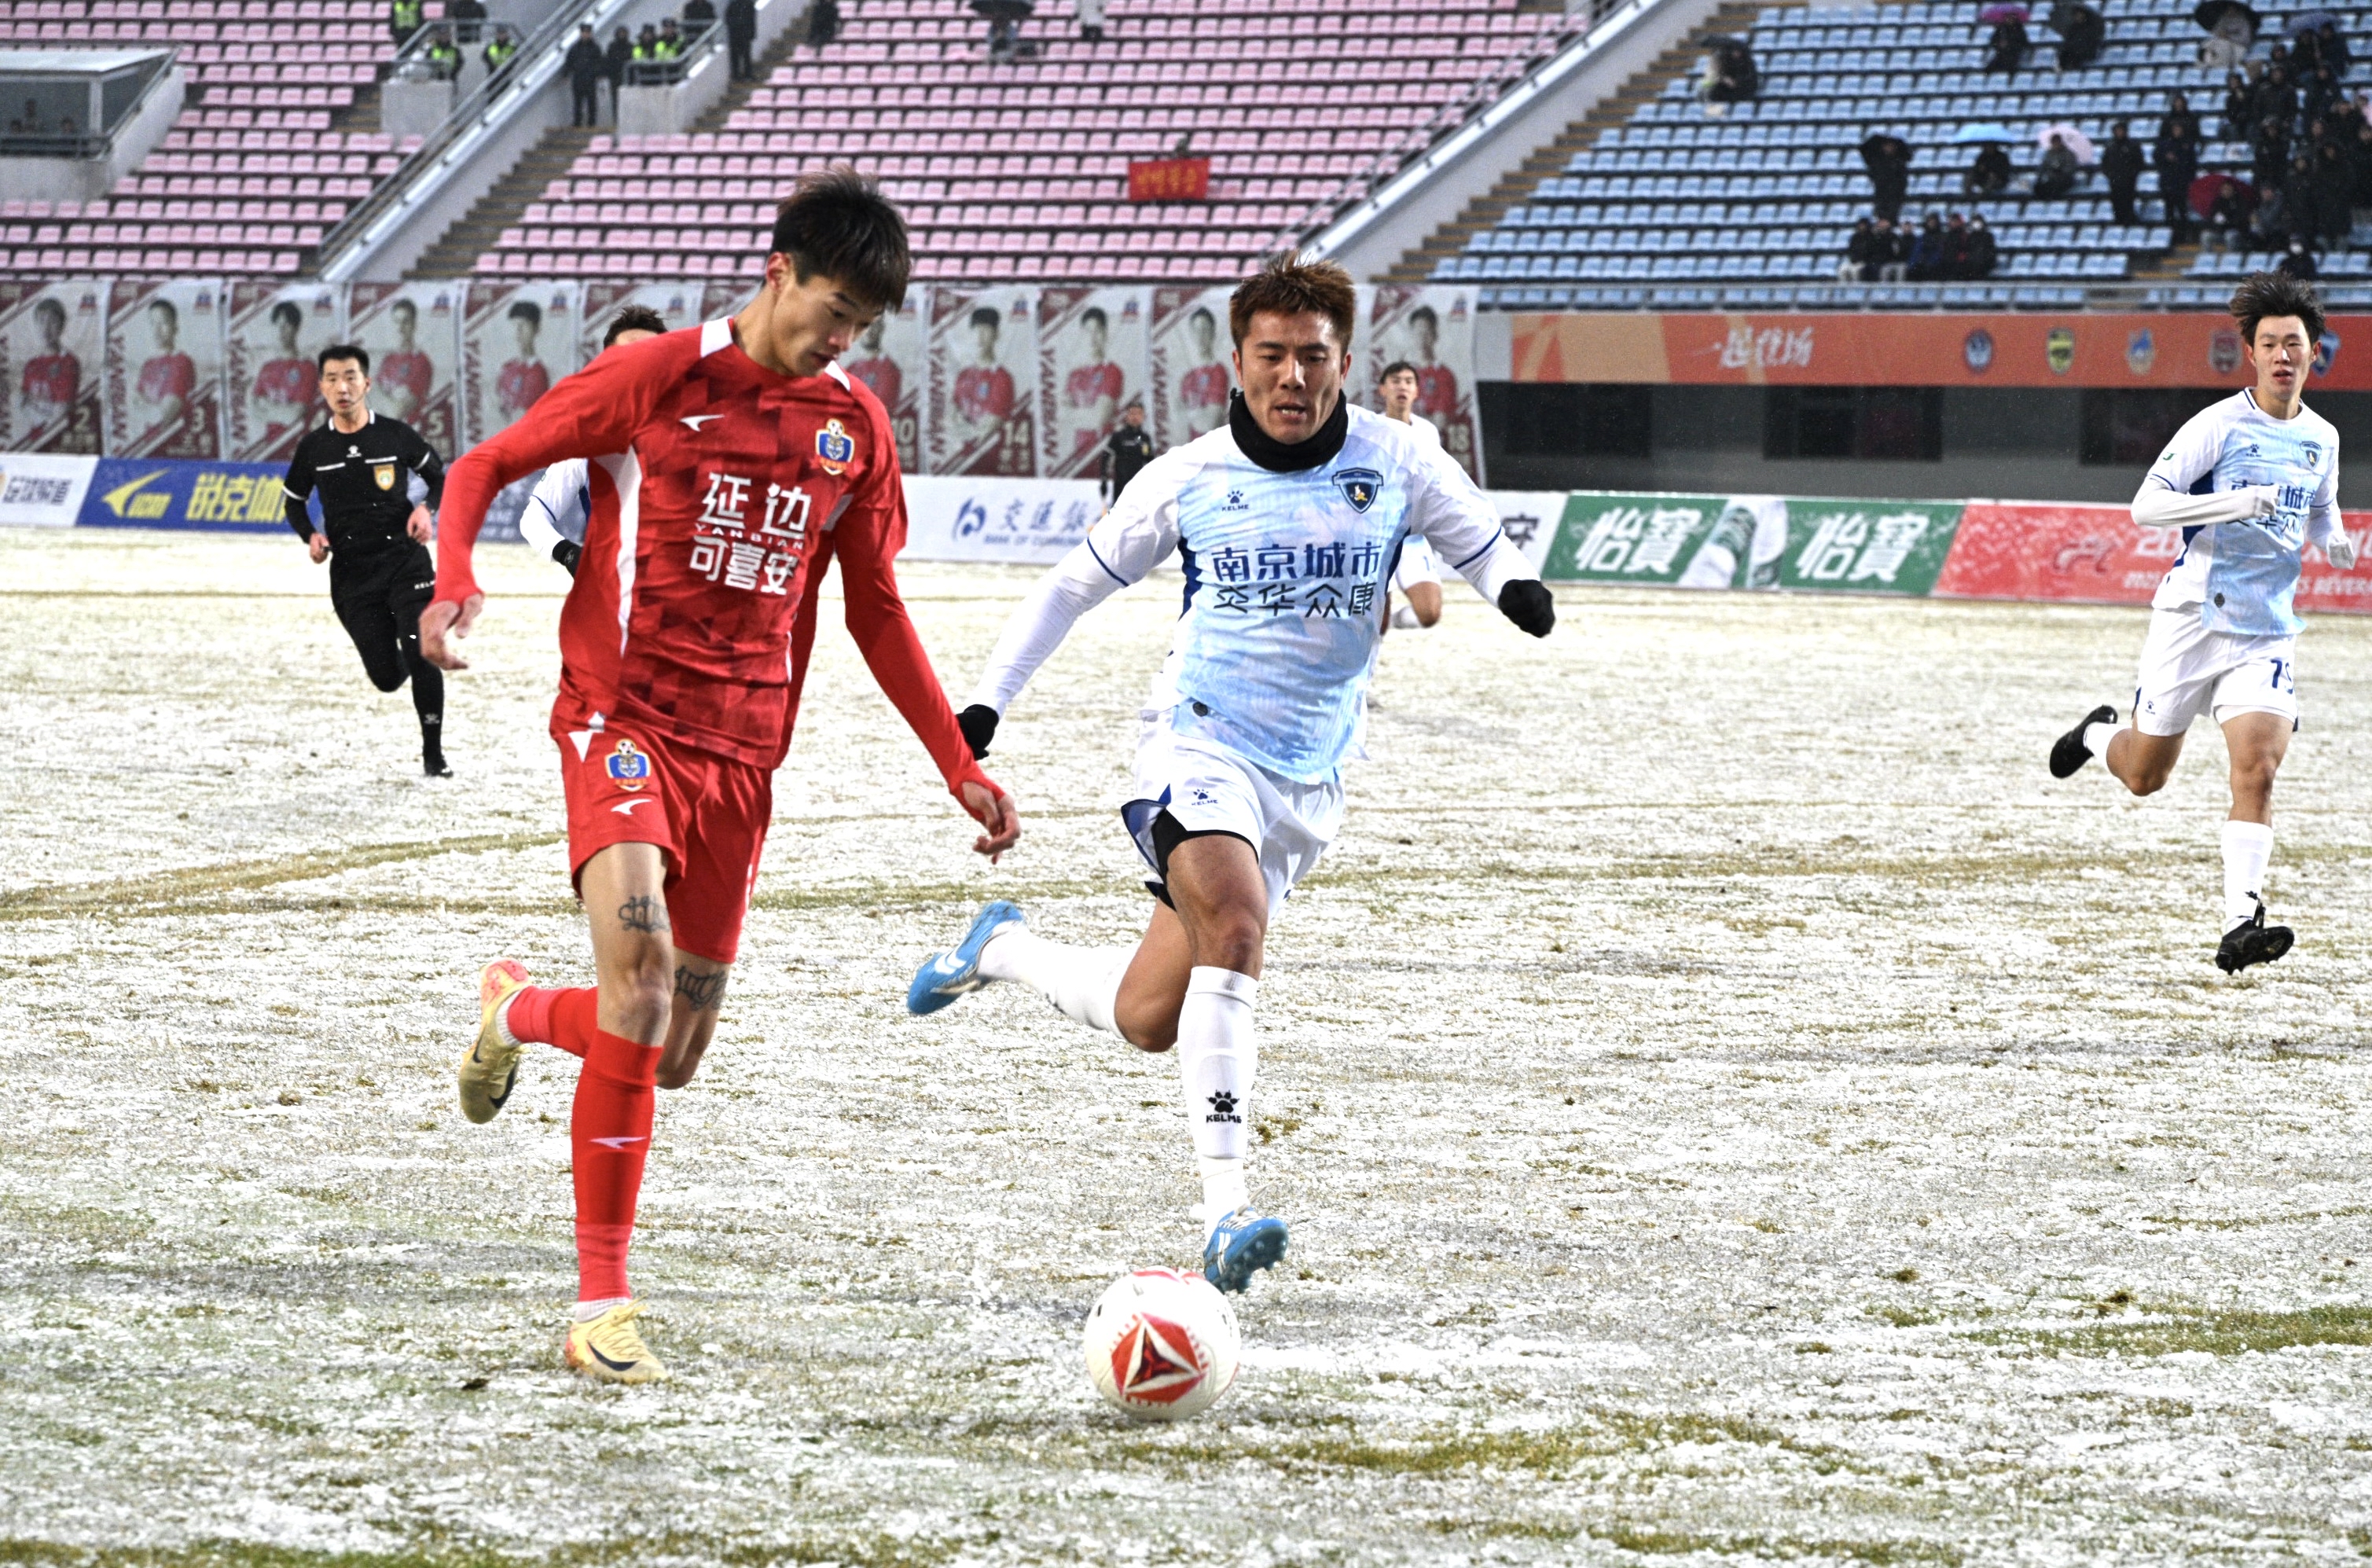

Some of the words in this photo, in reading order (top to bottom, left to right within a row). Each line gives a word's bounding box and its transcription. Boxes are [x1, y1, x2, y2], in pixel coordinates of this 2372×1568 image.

[74, 406, 90, 432] 2
[190, 406, 205, 433] 3
[891, 417, 916, 444] 10
[1004, 420, 1030, 446] 14
[697, 472, 812, 540] 延边
[694, 523, 804, 550] YANBIAN
[688, 534, 800, 597] 可喜安
[1211, 541, 1382, 582] 南京城市
[1206, 1114, 1243, 1124] KELME
